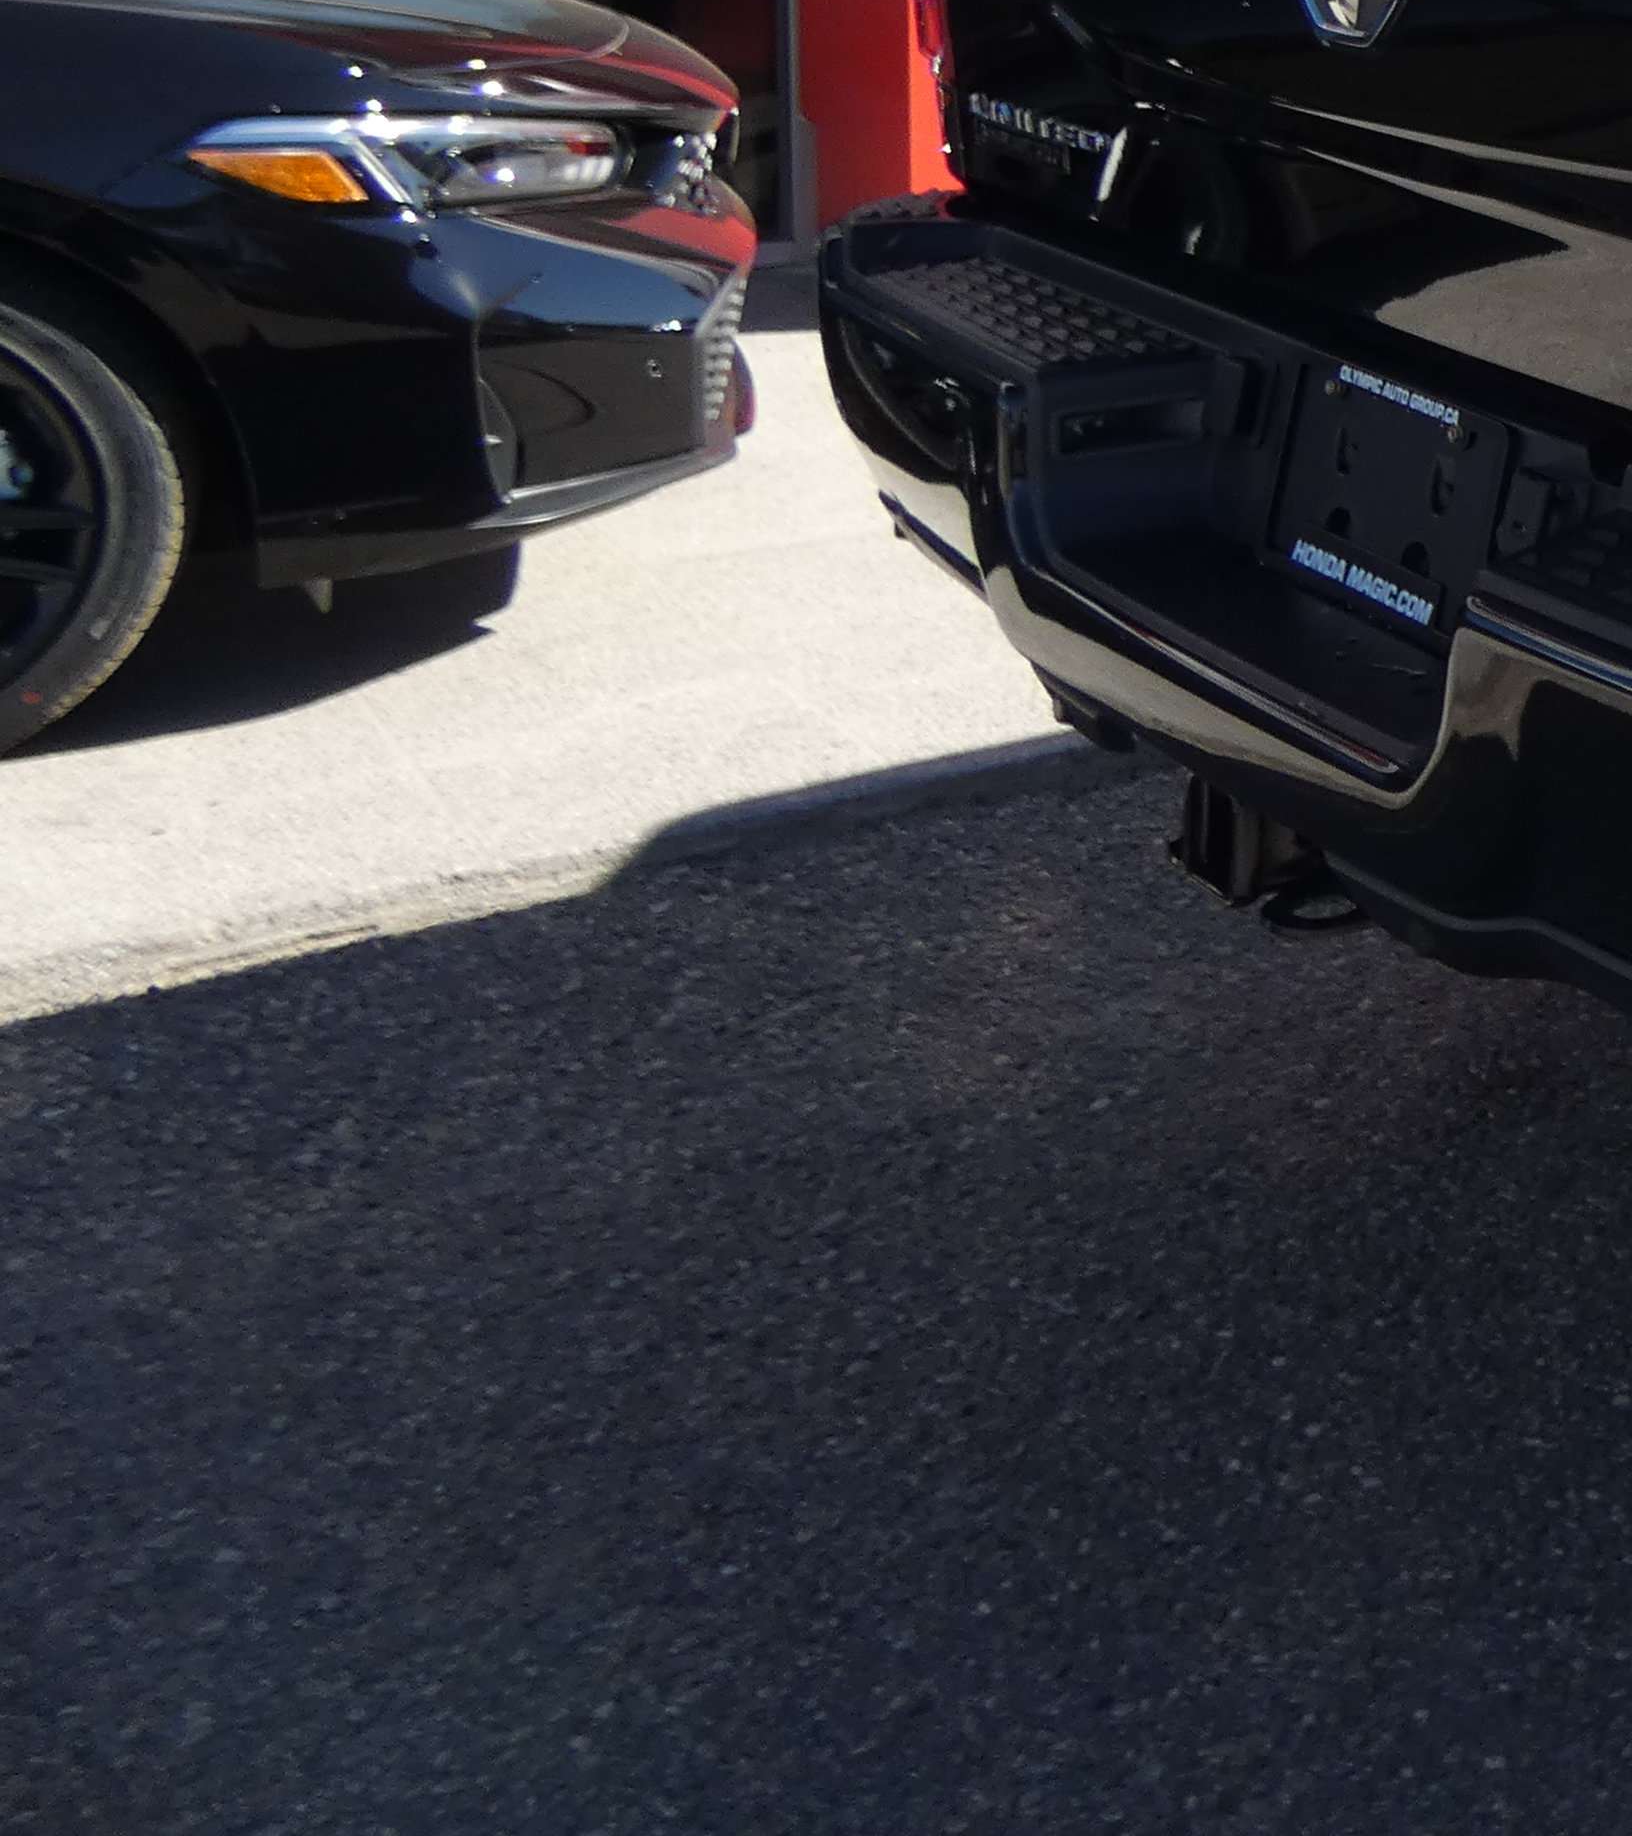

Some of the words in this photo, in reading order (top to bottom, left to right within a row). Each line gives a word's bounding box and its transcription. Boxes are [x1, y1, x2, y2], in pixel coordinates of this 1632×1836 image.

[1339, 363, 1384, 395] OLYMPIC
[1381, 381, 1410, 406] AUTO
[1290, 538, 1348, 583] HONDA
[1345, 563, 1435, 626] MAGIC.COM
